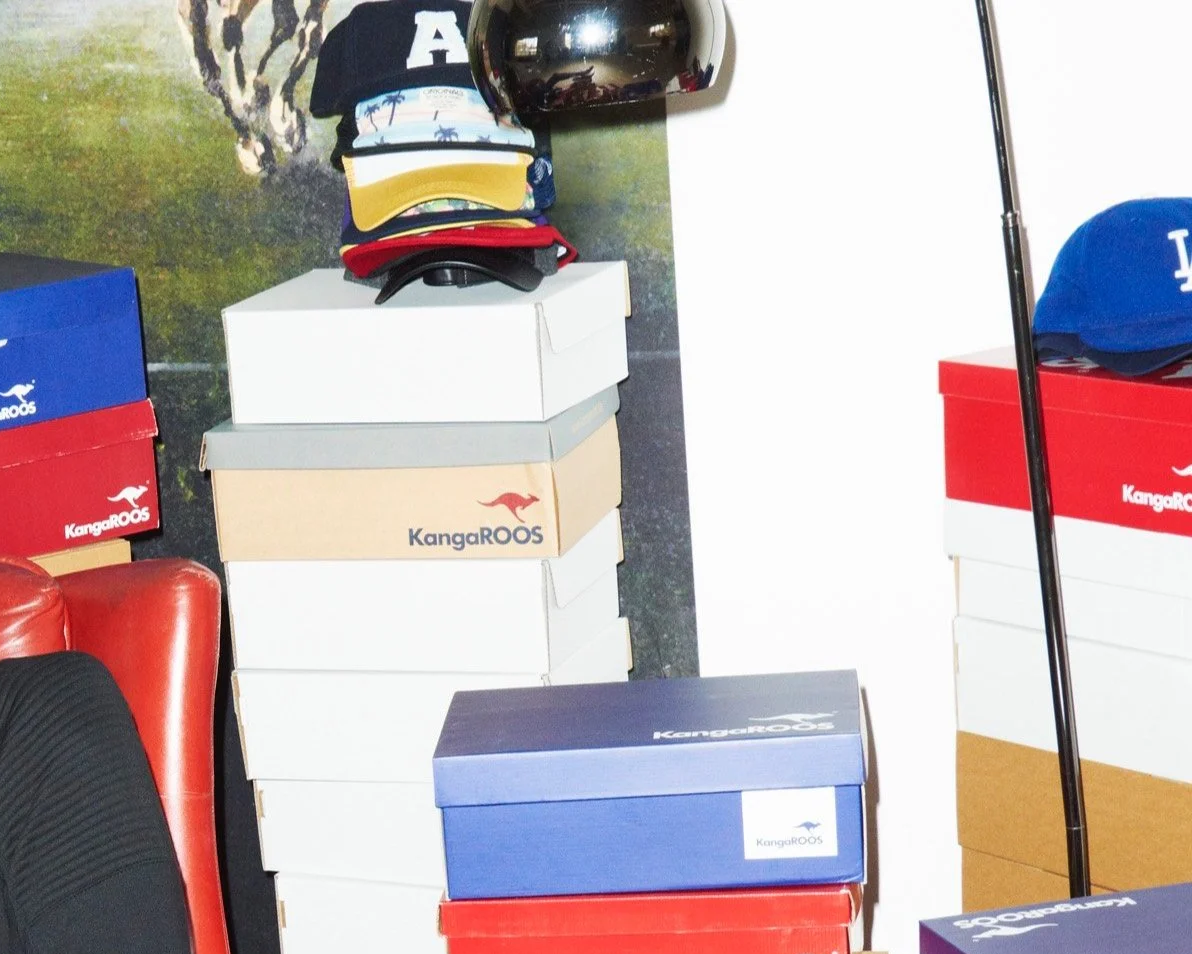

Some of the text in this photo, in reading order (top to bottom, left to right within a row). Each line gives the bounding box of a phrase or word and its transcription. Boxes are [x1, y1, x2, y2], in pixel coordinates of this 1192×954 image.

[406, 10, 471, 69] A
[64, 507, 150, 539] KangaROOS
[408, 526, 544, 551] KangaROOS
[653, 721, 835, 740] KangaROOS
[756, 836, 823, 849] KangaROOS
[953, 896, 1137, 929] KangaROOS
